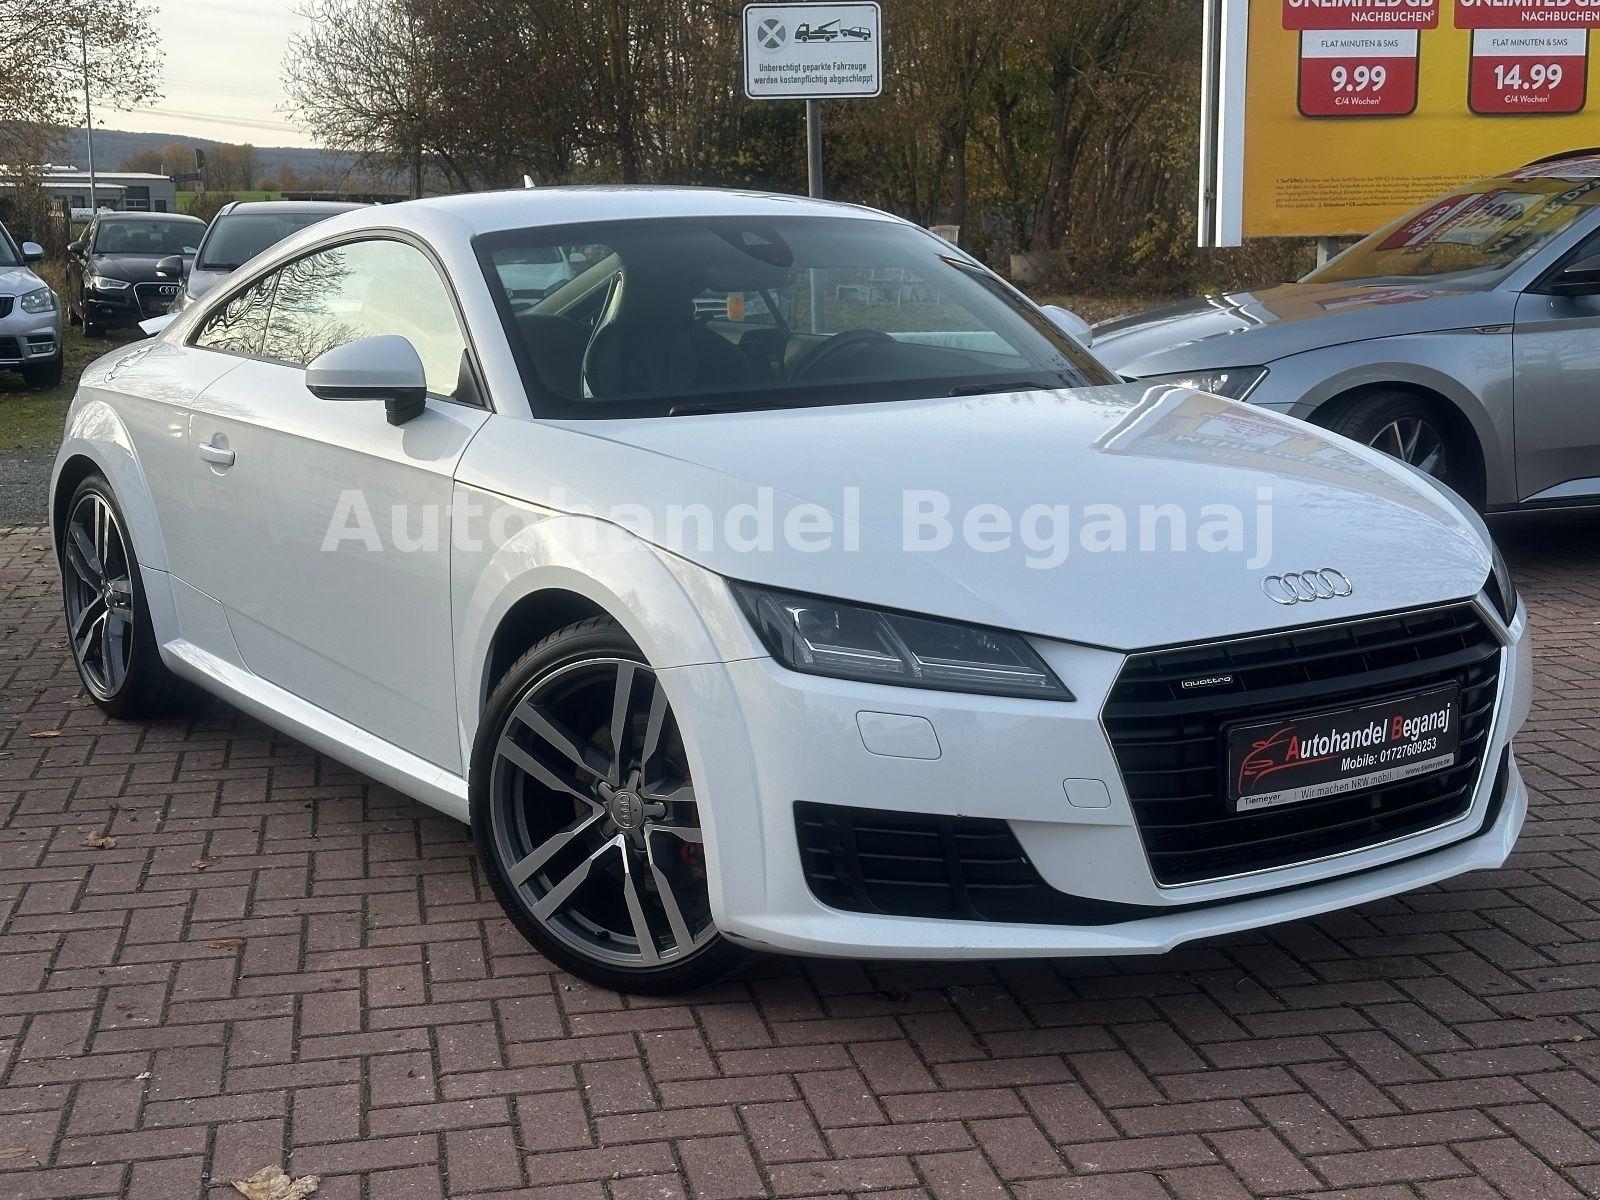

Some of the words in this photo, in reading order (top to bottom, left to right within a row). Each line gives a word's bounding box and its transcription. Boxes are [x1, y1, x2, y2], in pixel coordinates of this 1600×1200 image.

[754, 76, 778, 84] werden
[780, 74, 828, 85] kostenpflichtig
[830, 74, 872, 84] abgeschleppt
[759, 64, 800, 73] Unberechtigt
[802, 62, 831, 73] geparkte
[832, 62, 866, 72] Fahrzeuge
[1331, 66, 1386, 92] 9.99
[1494, 64, 1562, 90] 14.99
[1184, 676, 1231, 687] quattro
[1286, 718, 1388, 761] Autohandel
[1391, 703, 1450, 741] Beganaj
[1341, 754, 1378, 772] Mobile:
[1380, 737, 1437, 762] 01727609253
[1244, 794, 1282, 805] Tiemeyer
[1301, 789, 1316, 799] Wir
[1316, 782, 1349, 797] machen
[1351, 778, 1368, 789] NRW
